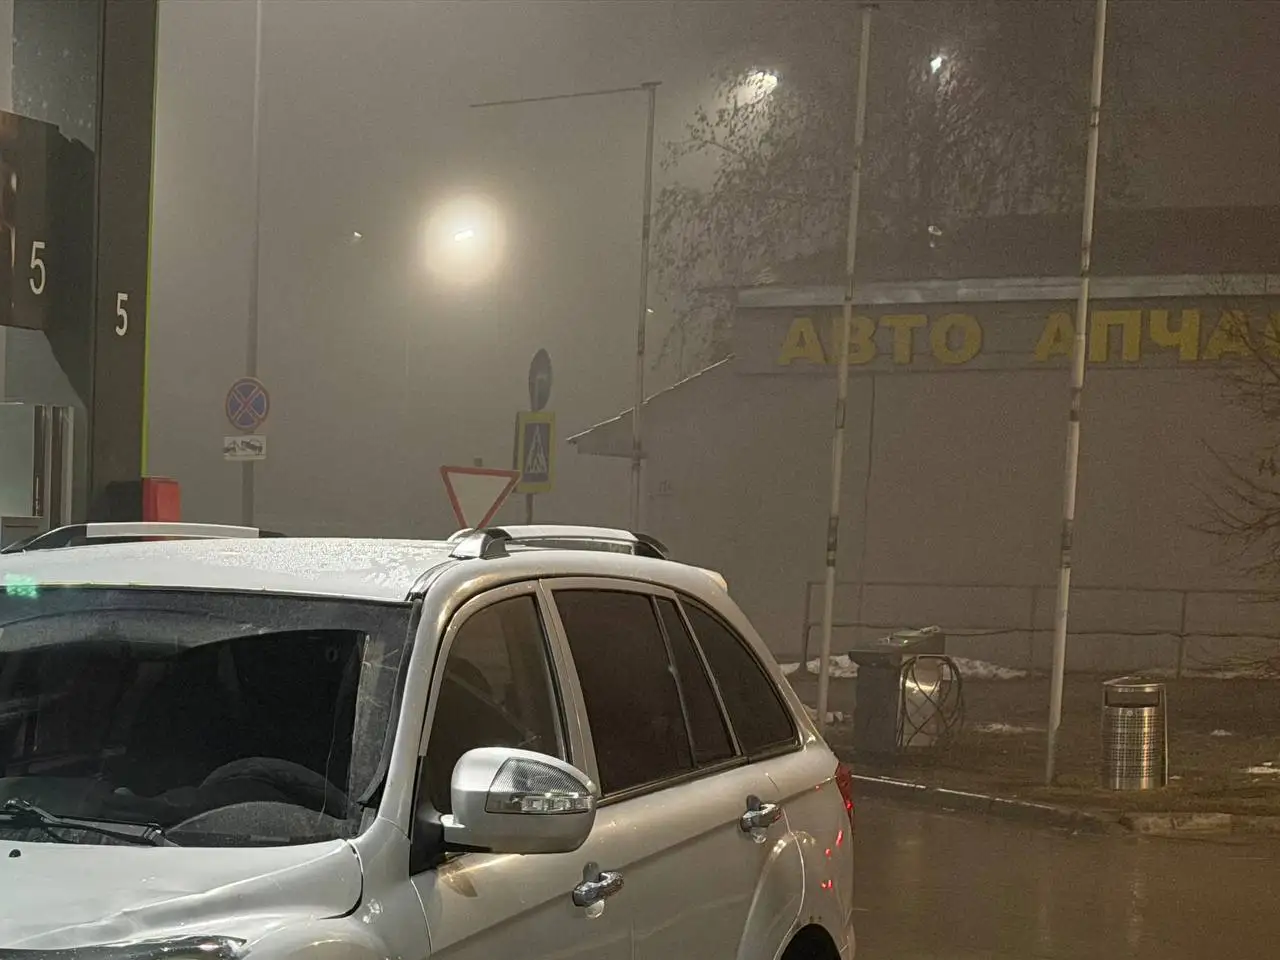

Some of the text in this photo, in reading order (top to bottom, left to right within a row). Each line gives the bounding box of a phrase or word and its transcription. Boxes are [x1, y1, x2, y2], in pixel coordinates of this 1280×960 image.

[29, 241, 46, 295] 5
[115, 292, 128, 336] 5
[777, 314, 984, 367] АВТО
